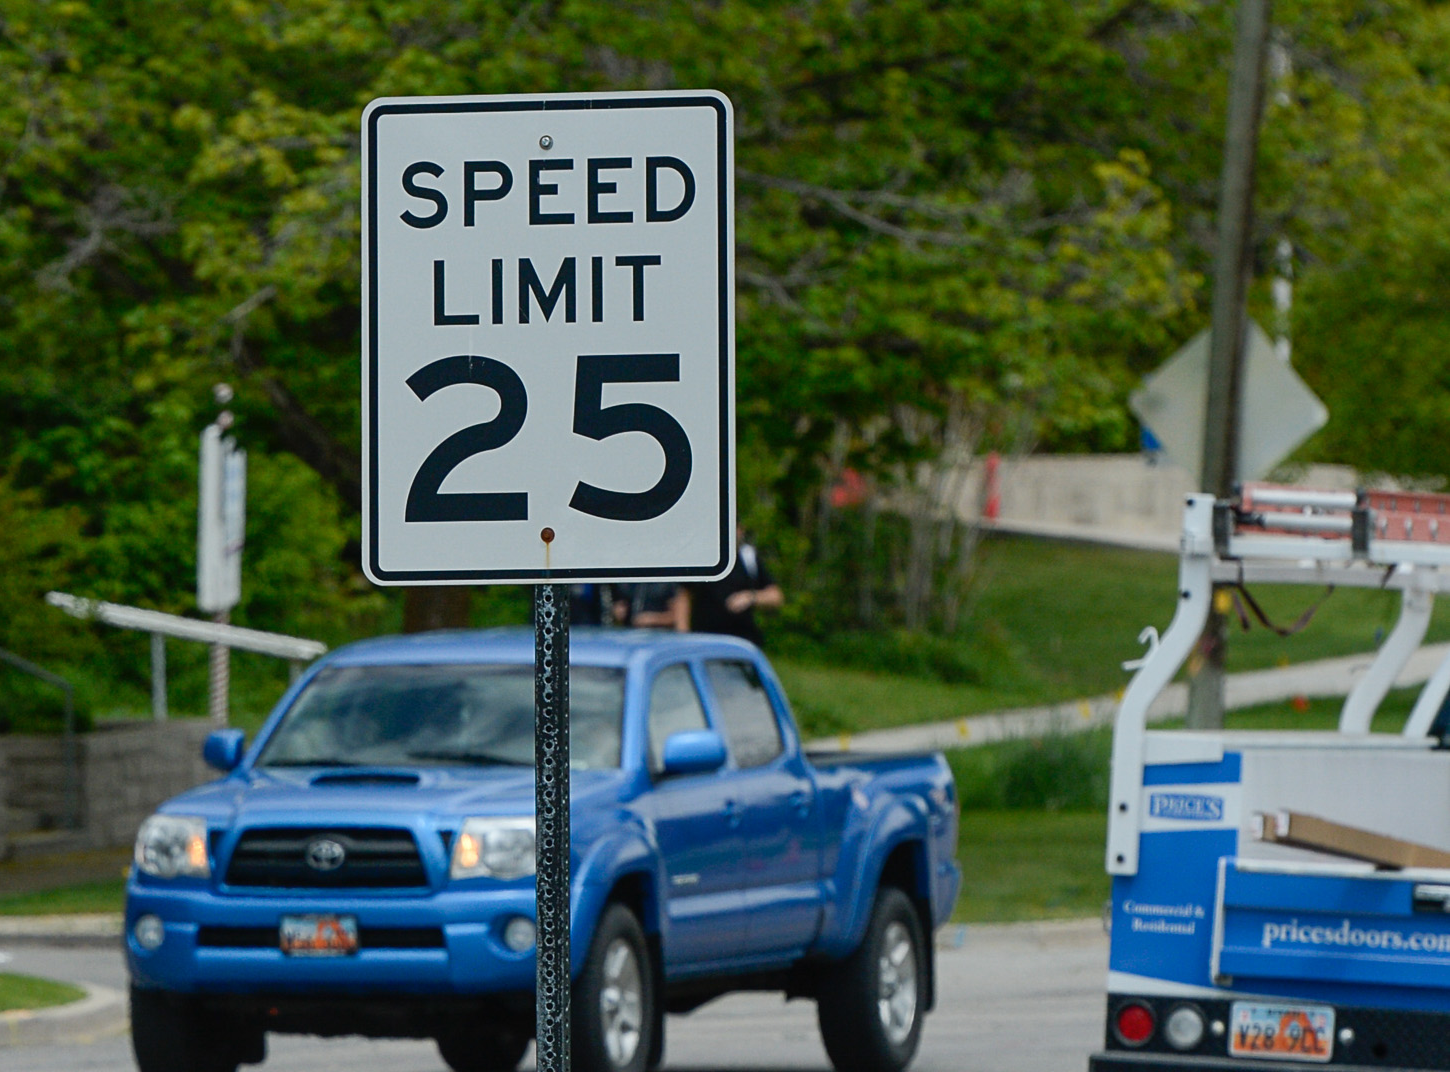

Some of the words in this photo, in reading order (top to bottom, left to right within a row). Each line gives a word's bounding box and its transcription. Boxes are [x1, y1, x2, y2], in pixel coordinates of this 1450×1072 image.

[399, 155, 697, 229] SPEED
[433, 254, 662, 326] LIMIT
[404, 352, 694, 522] 25
